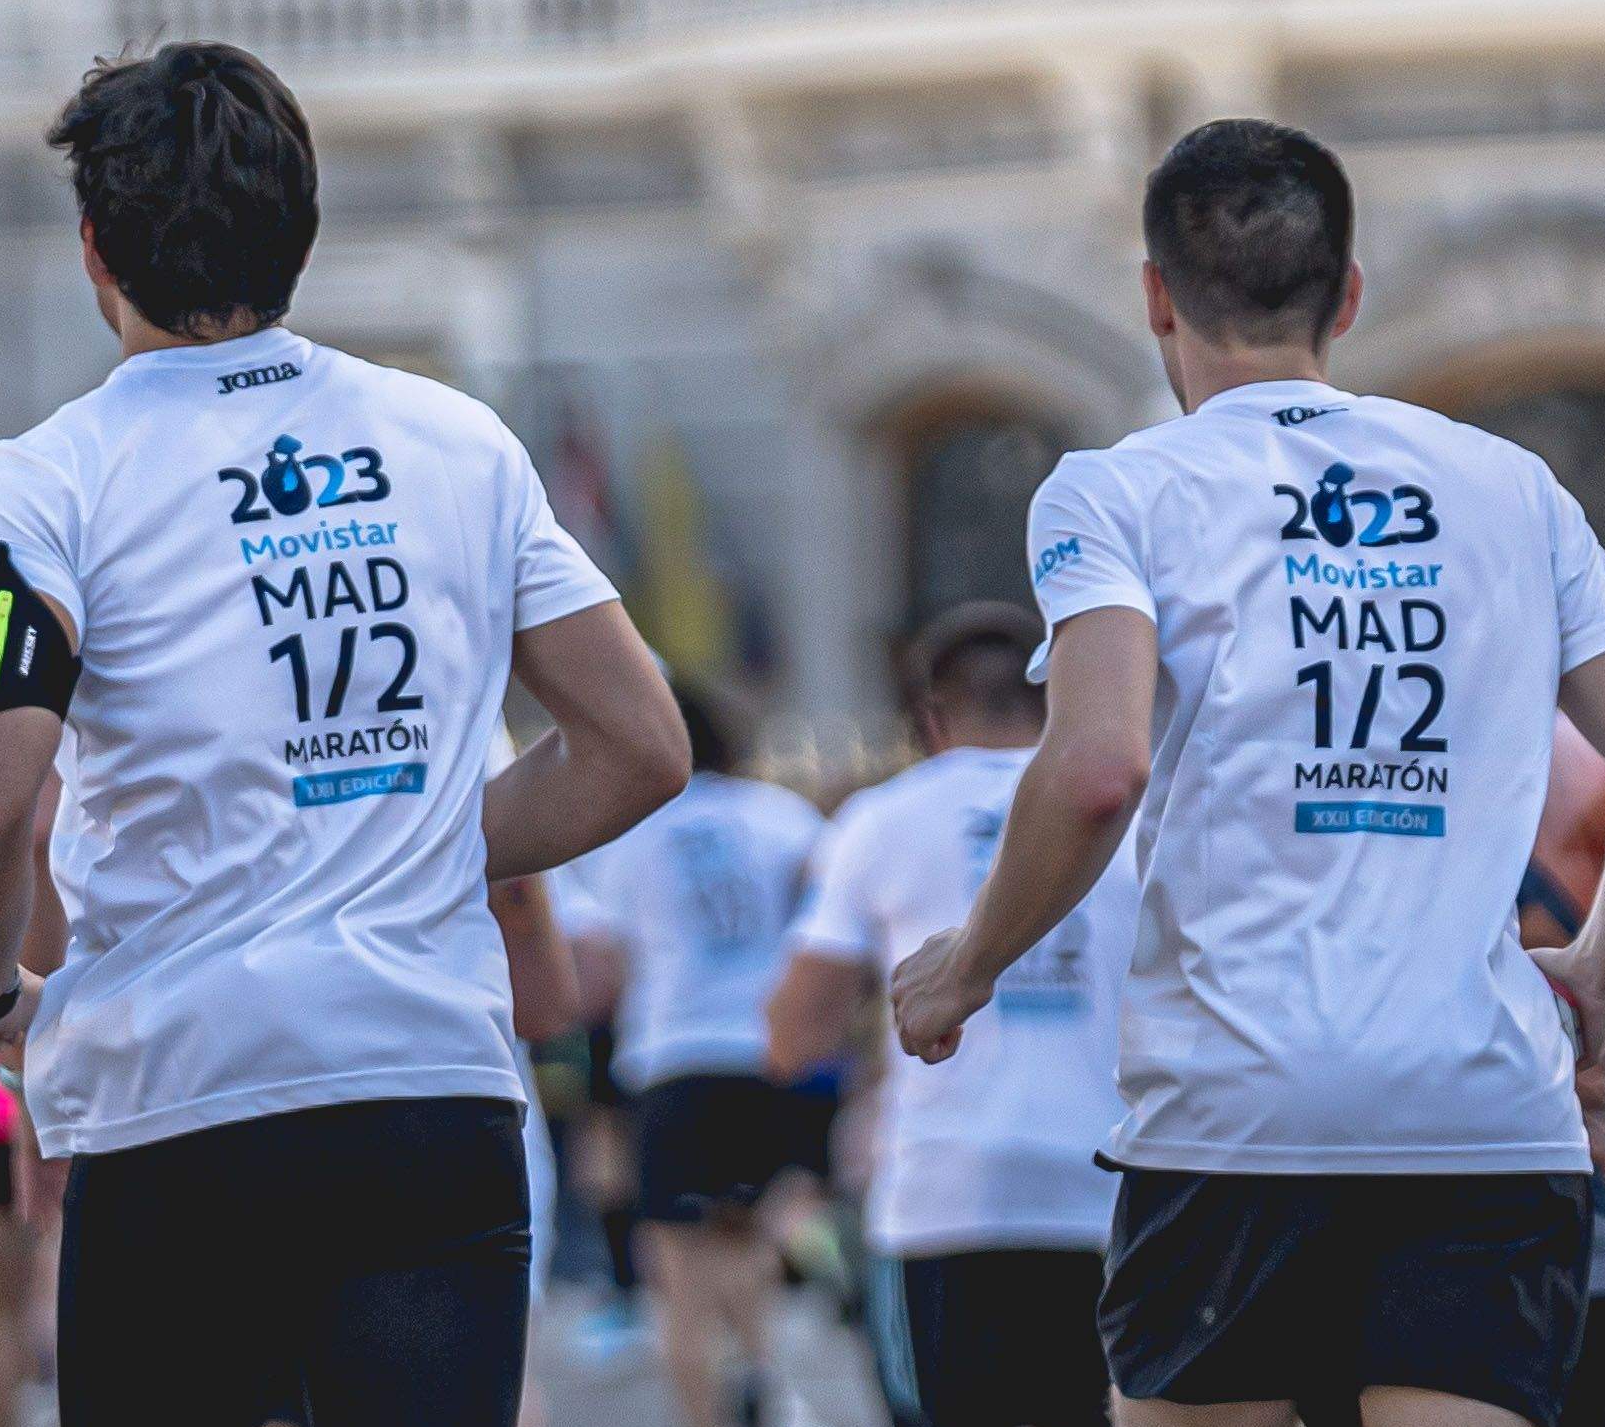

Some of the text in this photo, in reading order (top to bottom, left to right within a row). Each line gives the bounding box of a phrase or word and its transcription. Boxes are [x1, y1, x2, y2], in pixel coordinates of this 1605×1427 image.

[217, 362, 302, 394] Joma
[218, 436, 392, 524] 2023
[1274, 466, 1441, 547] 2023
[241, 517, 398, 566] Movistar
[251, 556, 409, 626] MAD
[1285, 552, 1443, 590] Movistar
[1289, 596, 1447, 654] MAD
[269, 622, 424, 723] 1/2
[1296, 659, 1449, 754] 1/2
[285, 718, 429, 766] MARATÓN
[1295, 759, 1448, 793] MARATÓN
